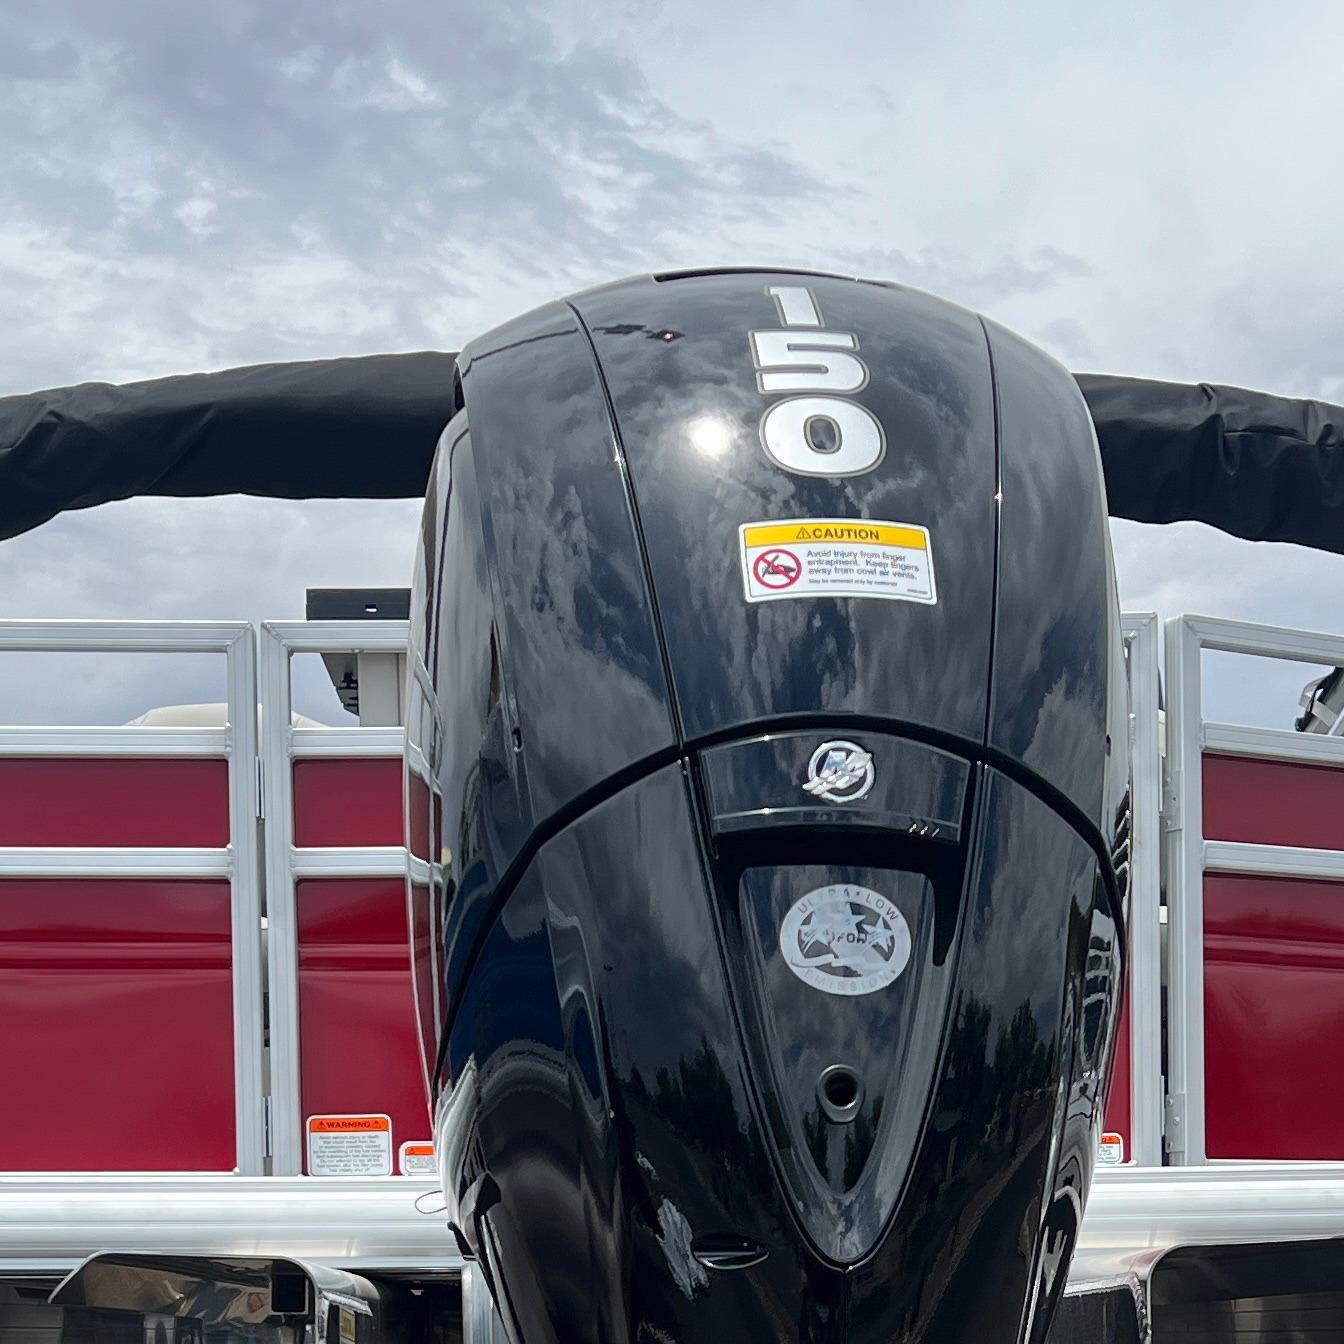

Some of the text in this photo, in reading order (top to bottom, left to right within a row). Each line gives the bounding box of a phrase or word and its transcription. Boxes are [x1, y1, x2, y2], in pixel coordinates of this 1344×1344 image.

[748, 284, 887, 478] 150
[812, 527, 880, 541] CAUTION
[806, 550, 832, 559] Avoid
[859, 551, 881, 560] from
[865, 559, 889, 569] Keep
[808, 568, 832, 576] away
[833, 567, 855, 575] from
[856, 567, 877, 576] cowl
[865, 893, 899, 920] LOW
[327, 1121, 371, 1129] WARNING
